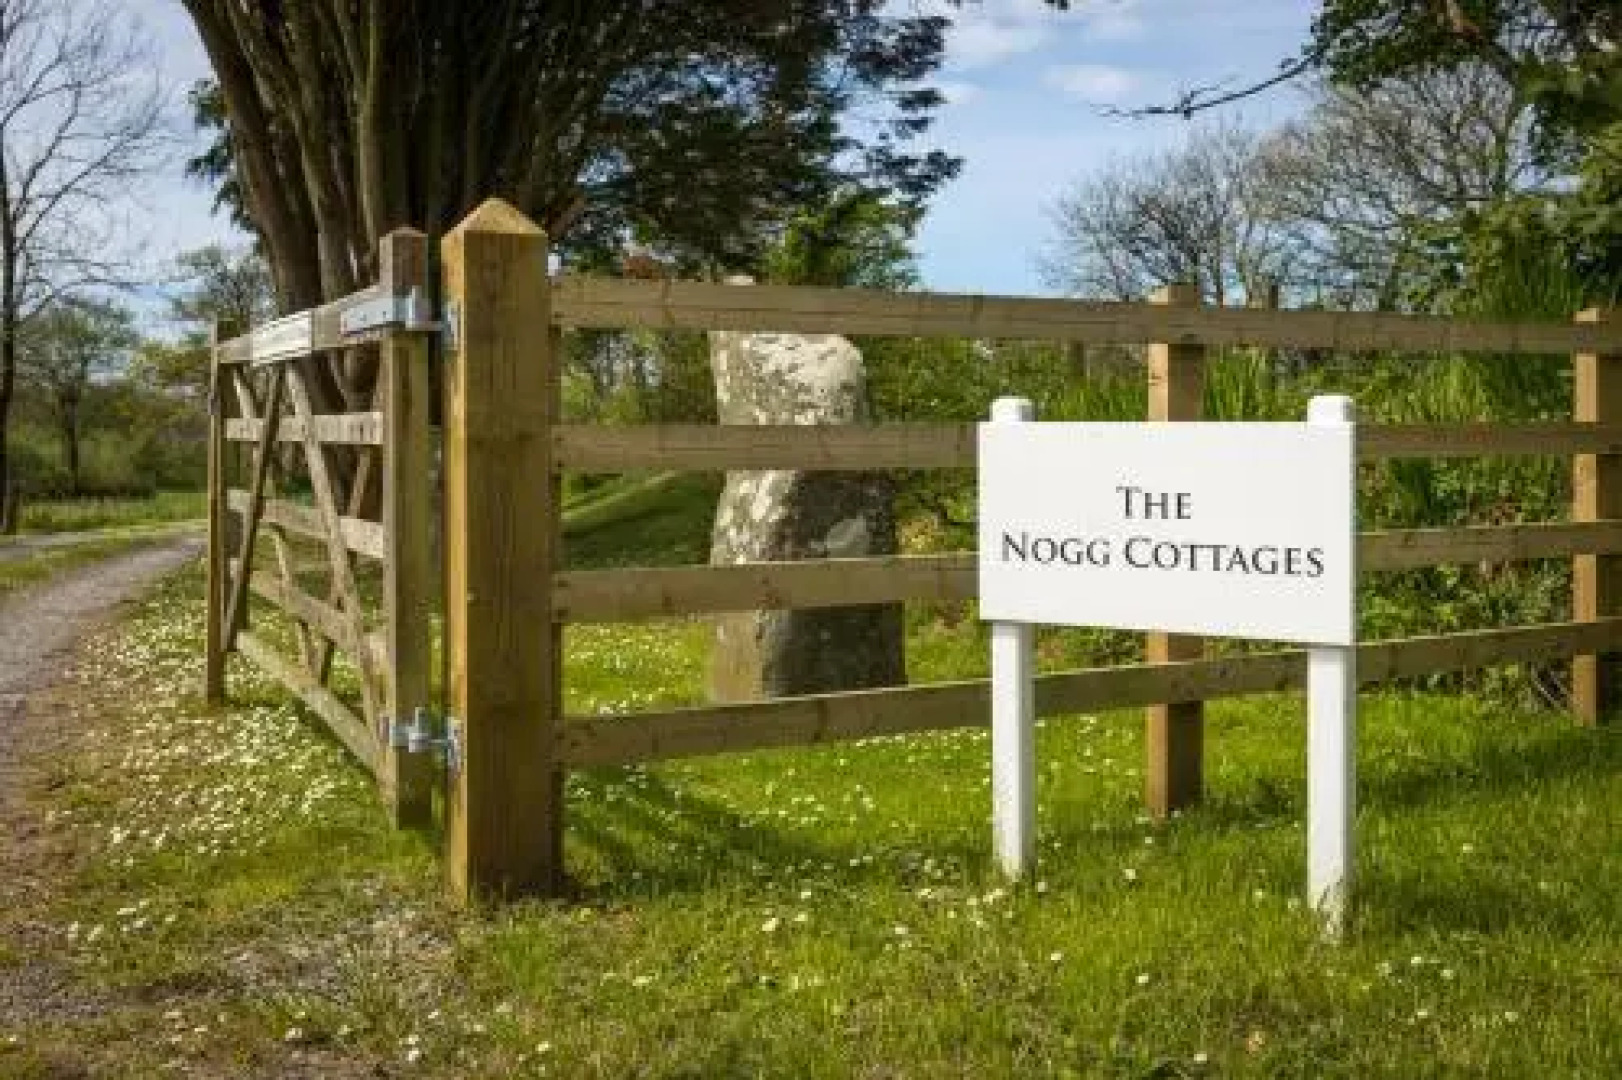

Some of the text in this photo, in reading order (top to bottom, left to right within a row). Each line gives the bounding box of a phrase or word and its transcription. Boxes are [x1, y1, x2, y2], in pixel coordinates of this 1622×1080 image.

[1115, 485, 1192, 520] THE
[1002, 532, 1325, 578] NOGG COTTAGES
